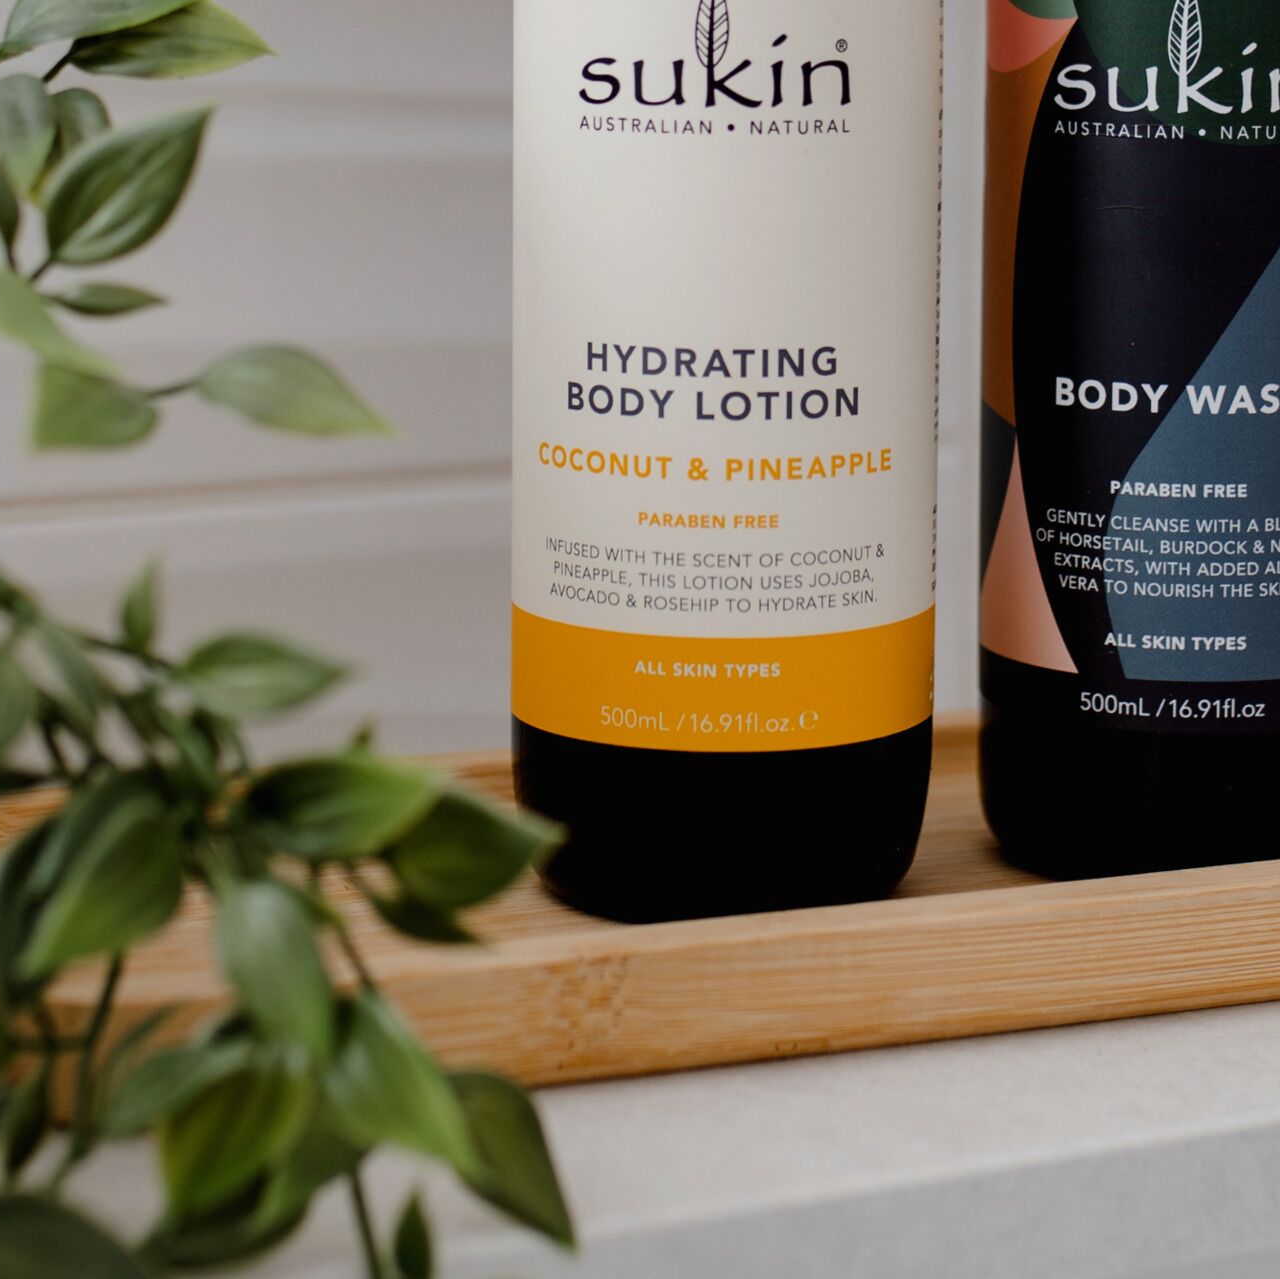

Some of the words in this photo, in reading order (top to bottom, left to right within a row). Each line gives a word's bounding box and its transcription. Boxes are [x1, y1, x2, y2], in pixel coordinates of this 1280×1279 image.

[579, 116, 713, 135] AUSTRALIAN
[750, 119, 851, 135] NATURAL
[1054, 120, 1184, 139] AUSTRALIAN
[587, 341, 838, 378] HYDRATING
[567, 381, 674, 418] BODY
[696, 387, 859, 420] LOTION
[1055, 376, 1169, 413] BODY
[539, 442, 672, 479] COCONUT
[687, 458, 709, 480] &
[726, 448, 892, 481] PINEAPPLE
[1110, 480, 1196, 498] PARABEN
[1203, 483, 1248, 498] FREE
[638, 512, 726, 528] PARABEN
[734, 514, 779, 528] FREE
[1047, 508, 1106, 528] GENTLY
[1110, 515, 1190, 533] CLEANSE
[1196, 519, 1240, 533] WITH
[1247, 519, 1259, 533] A
[545, 536, 600, 560] INFUSED
[605, 548, 645, 565] WITH
[653, 551, 685, 567] THE
[692, 553, 752, 568] SCENT
[759, 553, 784, 568] OF
[790, 545, 872, 567] COCONUT
[876, 543, 885, 558] &
[1036, 528, 1055, 542] OF
[1059, 531, 1153, 556] HORSETAIL,
[1160, 540, 1247, 555] BURDOCK
[1253, 540, 1264, 554] &
[553, 561, 632, 587] PINEAPPLE,
[639, 572, 675, 589] THIS
[683, 575, 752, 590] LOTION
[760, 573, 803, 590] USES
[809, 568, 874, 587] JOJOBA,
[1054, 552, 1140, 576] EXTRACTS,
[1145, 561, 1190, 576] WITH
[1197, 560, 1259, 576] ADDED
[550, 582, 620, 607] AVOCADO
[626, 593, 636, 608] &
[644, 595, 719, 612] ROSEHIP
[726, 598, 751, 613] TO
[758, 594, 836, 612] HYDRATE
[842, 589, 878, 606] SKIN.
[1059, 574, 1098, 592] VERA
[1103, 579, 1127, 595] TO
[1134, 581, 1213, 598] NOURISH
[1220, 584, 1253, 598] THE
[1104, 632, 1136, 648] ALL
[1141, 635, 1185, 650] SKIN
[1191, 636, 1247, 651] TYPES
[635, 660, 666, 676] ALL
[673, 662, 717, 678] SKIN
[724, 663, 780, 678] TYPES
[1080, 692, 1150, 717] 500mL
[600, 705, 670, 731] 500mL
